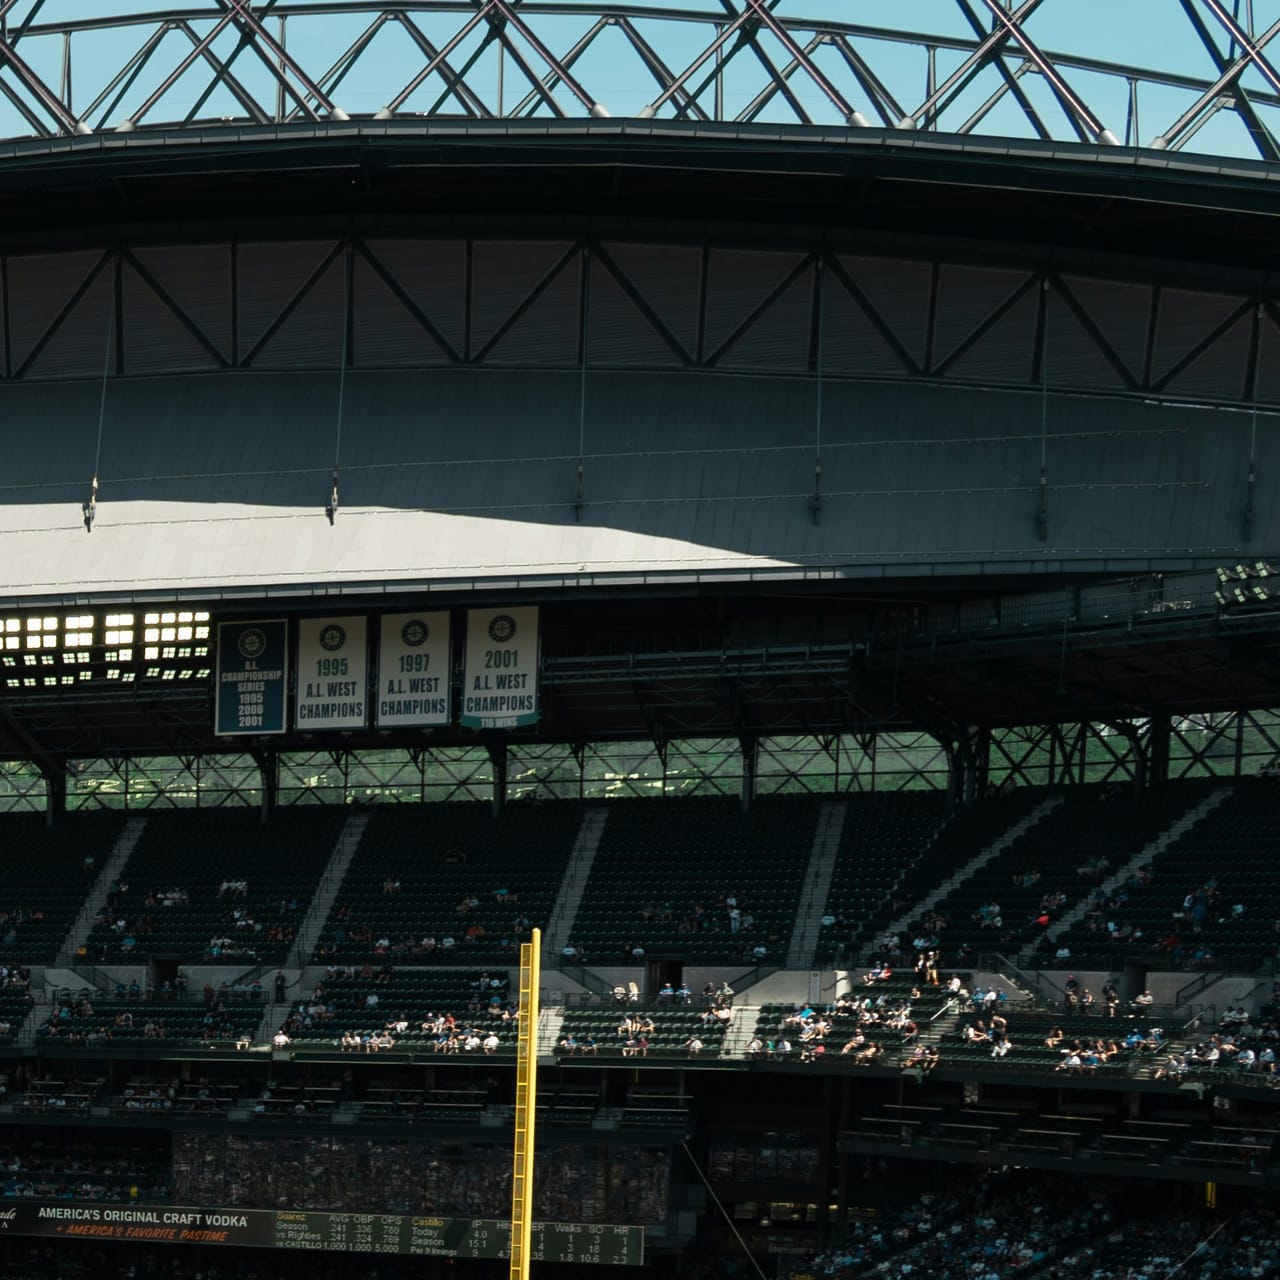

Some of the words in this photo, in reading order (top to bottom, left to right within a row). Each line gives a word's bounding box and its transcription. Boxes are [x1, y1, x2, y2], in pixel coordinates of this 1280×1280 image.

[316, 658, 349, 677] 1995
[398, 654, 431, 673] 1997
[485, 649, 518, 669] 2001
[221, 670, 283, 682] CHAMPIONSHIP
[473, 675, 493, 691] A.L.
[496, 673, 528, 690] WEST
[237, 681, 265, 692] SERIES
[306, 683, 325, 699] A.L.
[327, 681, 358, 698] WEST
[387, 679, 406, 695] A.L.
[409, 677, 440, 694] WEST
[239, 693, 264, 704] 1995
[380, 698, 446, 716] CHAMPIONS
[466, 695, 534, 713] CHAMPIONS
[238, 704, 264, 716] 2000
[299, 702, 363, 720] CHAMPIONS
[238, 716, 263, 727] 2001
[38, 1207, 101, 1221] AMERICA'S
[103, 1210, 160, 1224] ORIGINAL
[163, 1212, 202, 1226] CRAFT
[205, 1214, 249, 1227] VODKA
[65, 1224, 124, 1238] AMERICA'S
[125, 1227, 177, 1240] FAVORITE
[179, 1229, 229, 1242] PASTIME
